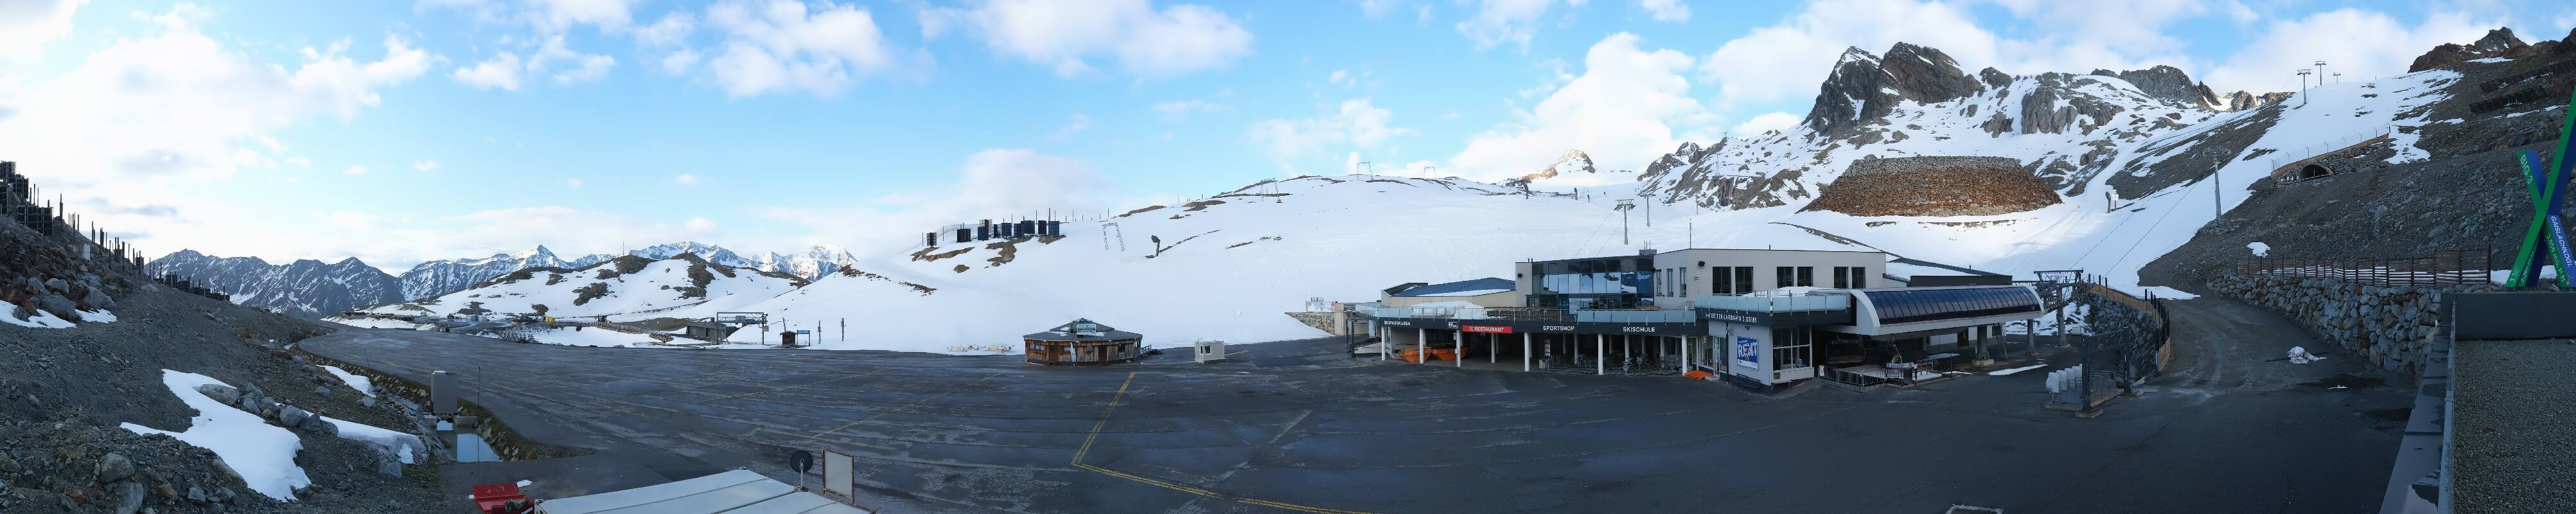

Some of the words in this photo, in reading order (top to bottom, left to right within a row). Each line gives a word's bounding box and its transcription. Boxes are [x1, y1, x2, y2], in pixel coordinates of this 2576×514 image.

[2520, 154, 2530, 175] BIG
[2527, 175, 2533, 184] 3
[2551, 216, 2573, 267] GAISLACHKOGL
